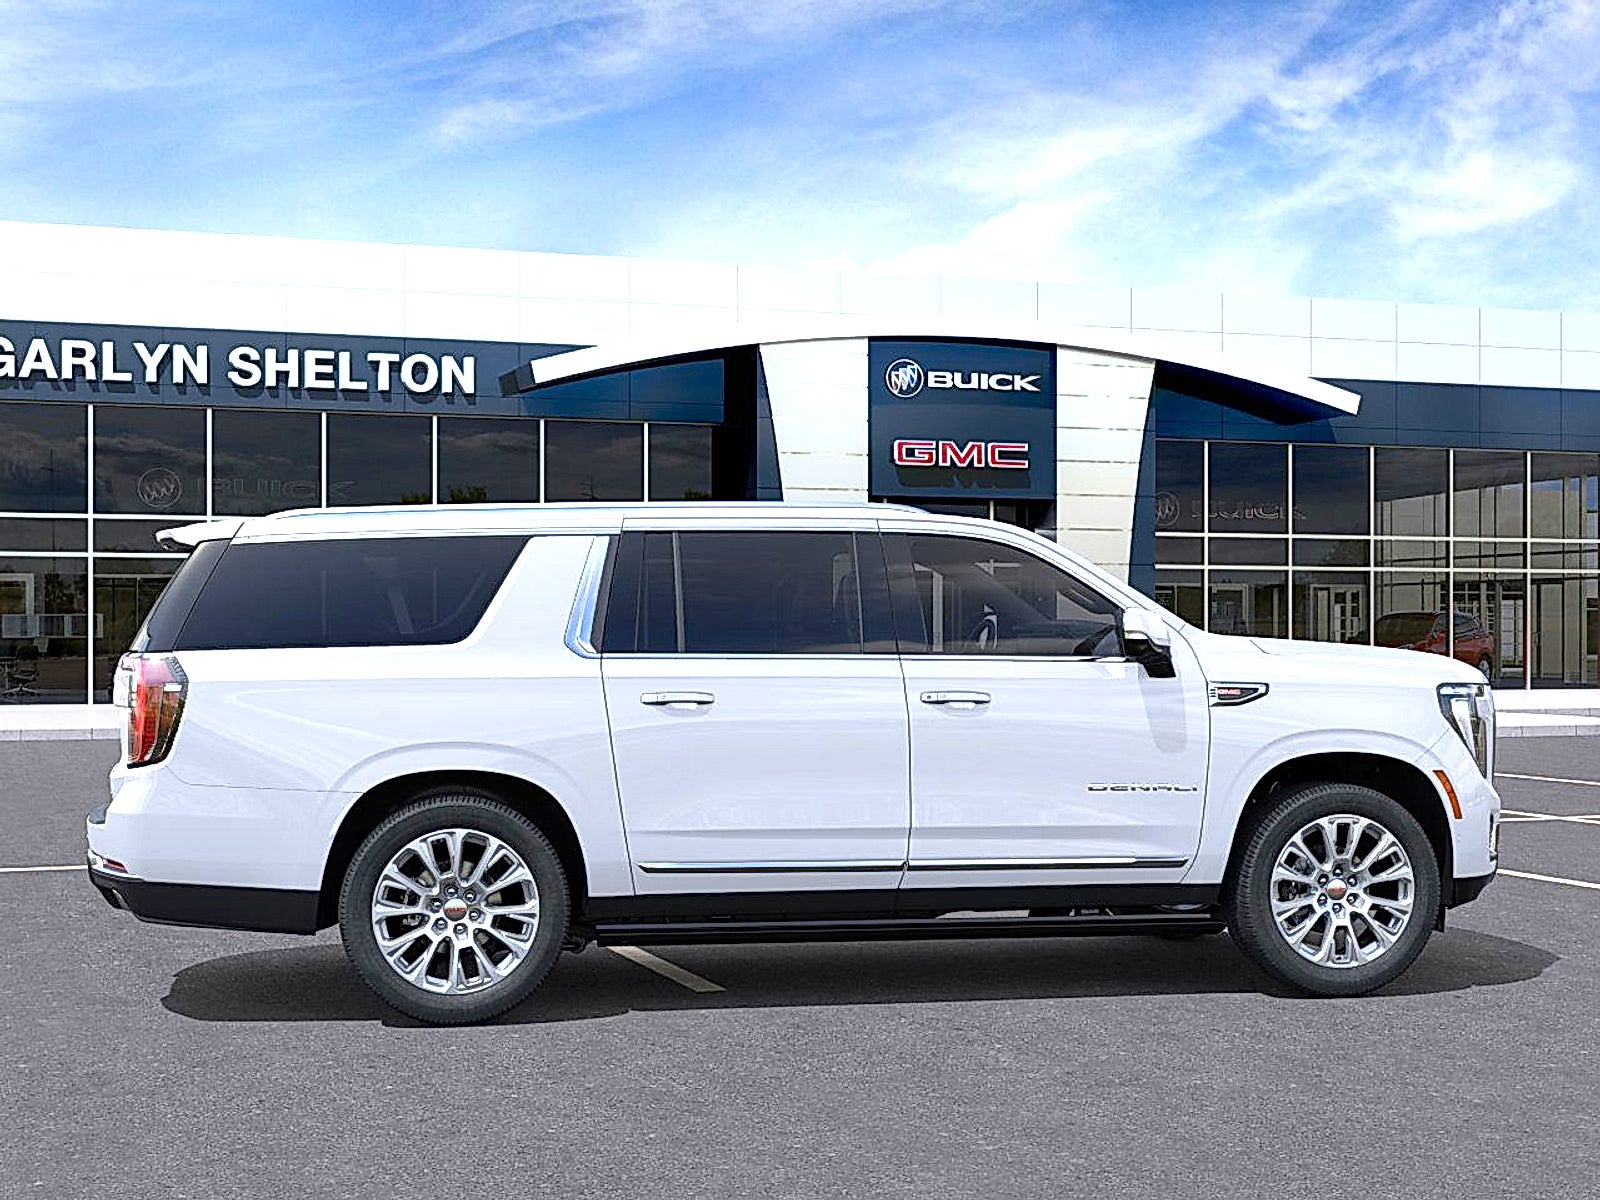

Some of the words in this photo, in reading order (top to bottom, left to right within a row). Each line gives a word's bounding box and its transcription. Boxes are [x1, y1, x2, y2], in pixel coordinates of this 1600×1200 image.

[228, 347, 474, 393] SHELTON
[928, 372, 1038, 390] BUICK
[894, 440, 1028, 468] GMC
[1088, 782, 1198, 792] DENALI
